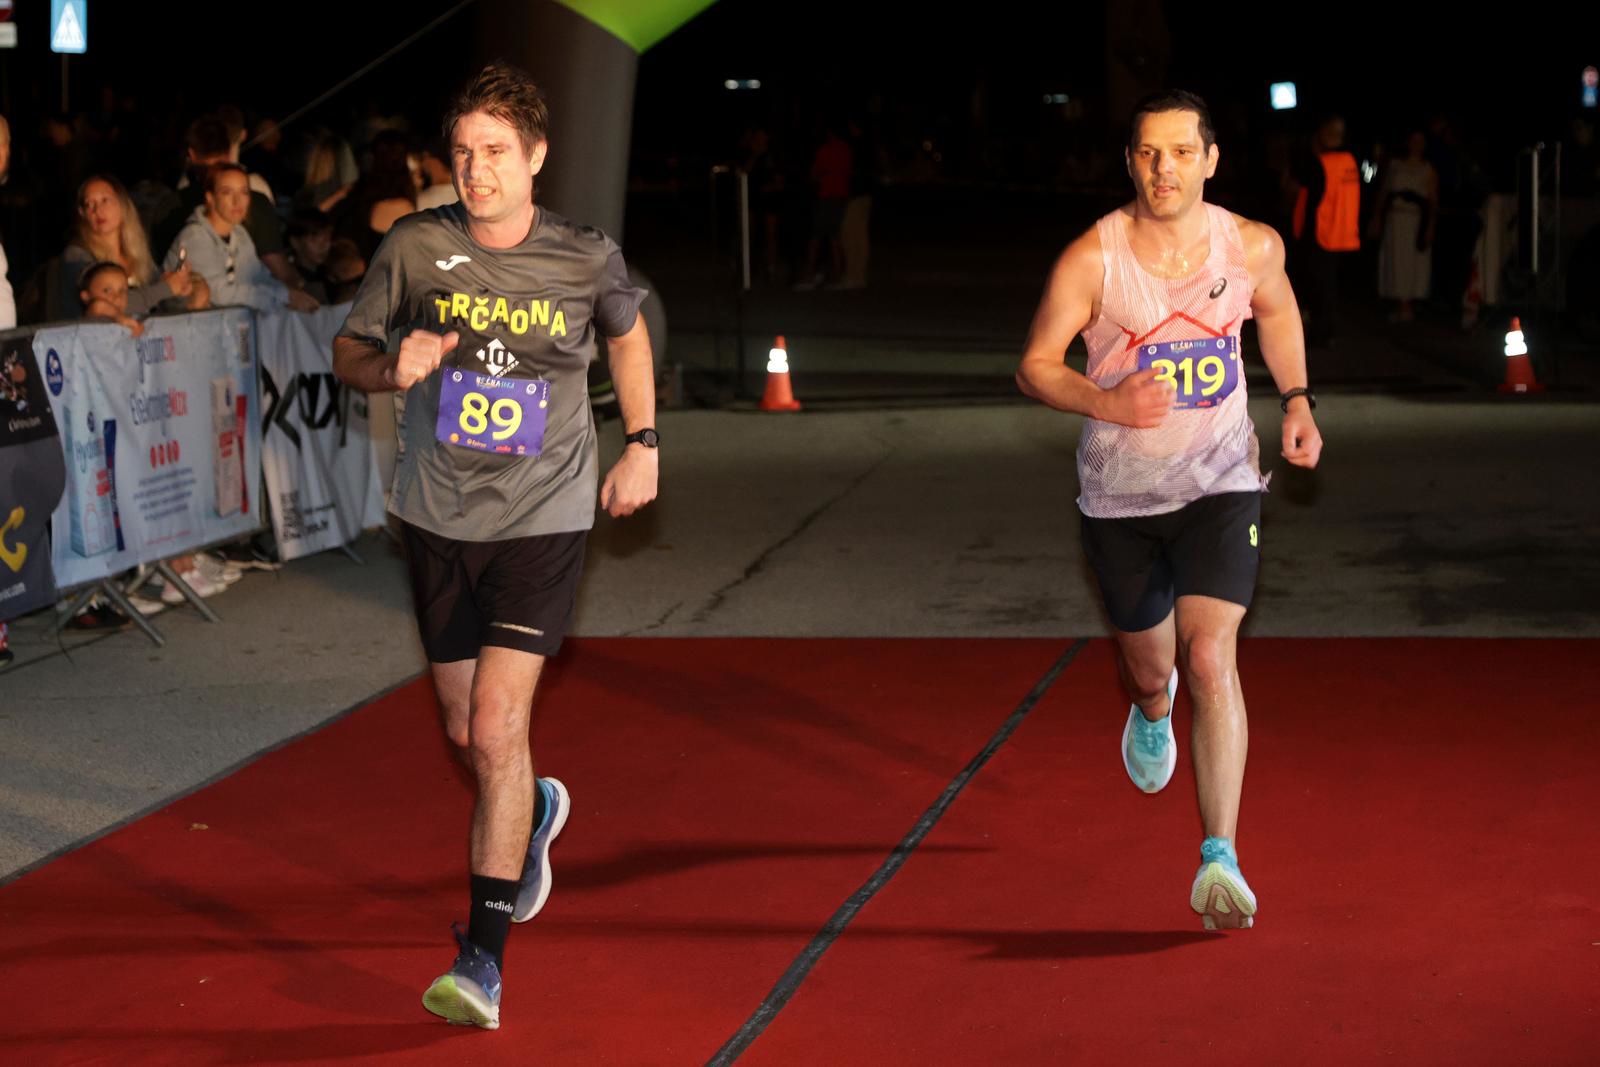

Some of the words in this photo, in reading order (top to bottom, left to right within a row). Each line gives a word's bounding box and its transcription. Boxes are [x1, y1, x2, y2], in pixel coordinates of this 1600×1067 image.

[435, 293, 567, 337] TRČAONA
[1151, 355, 1226, 397] 319
[458, 391, 523, 441] 89
